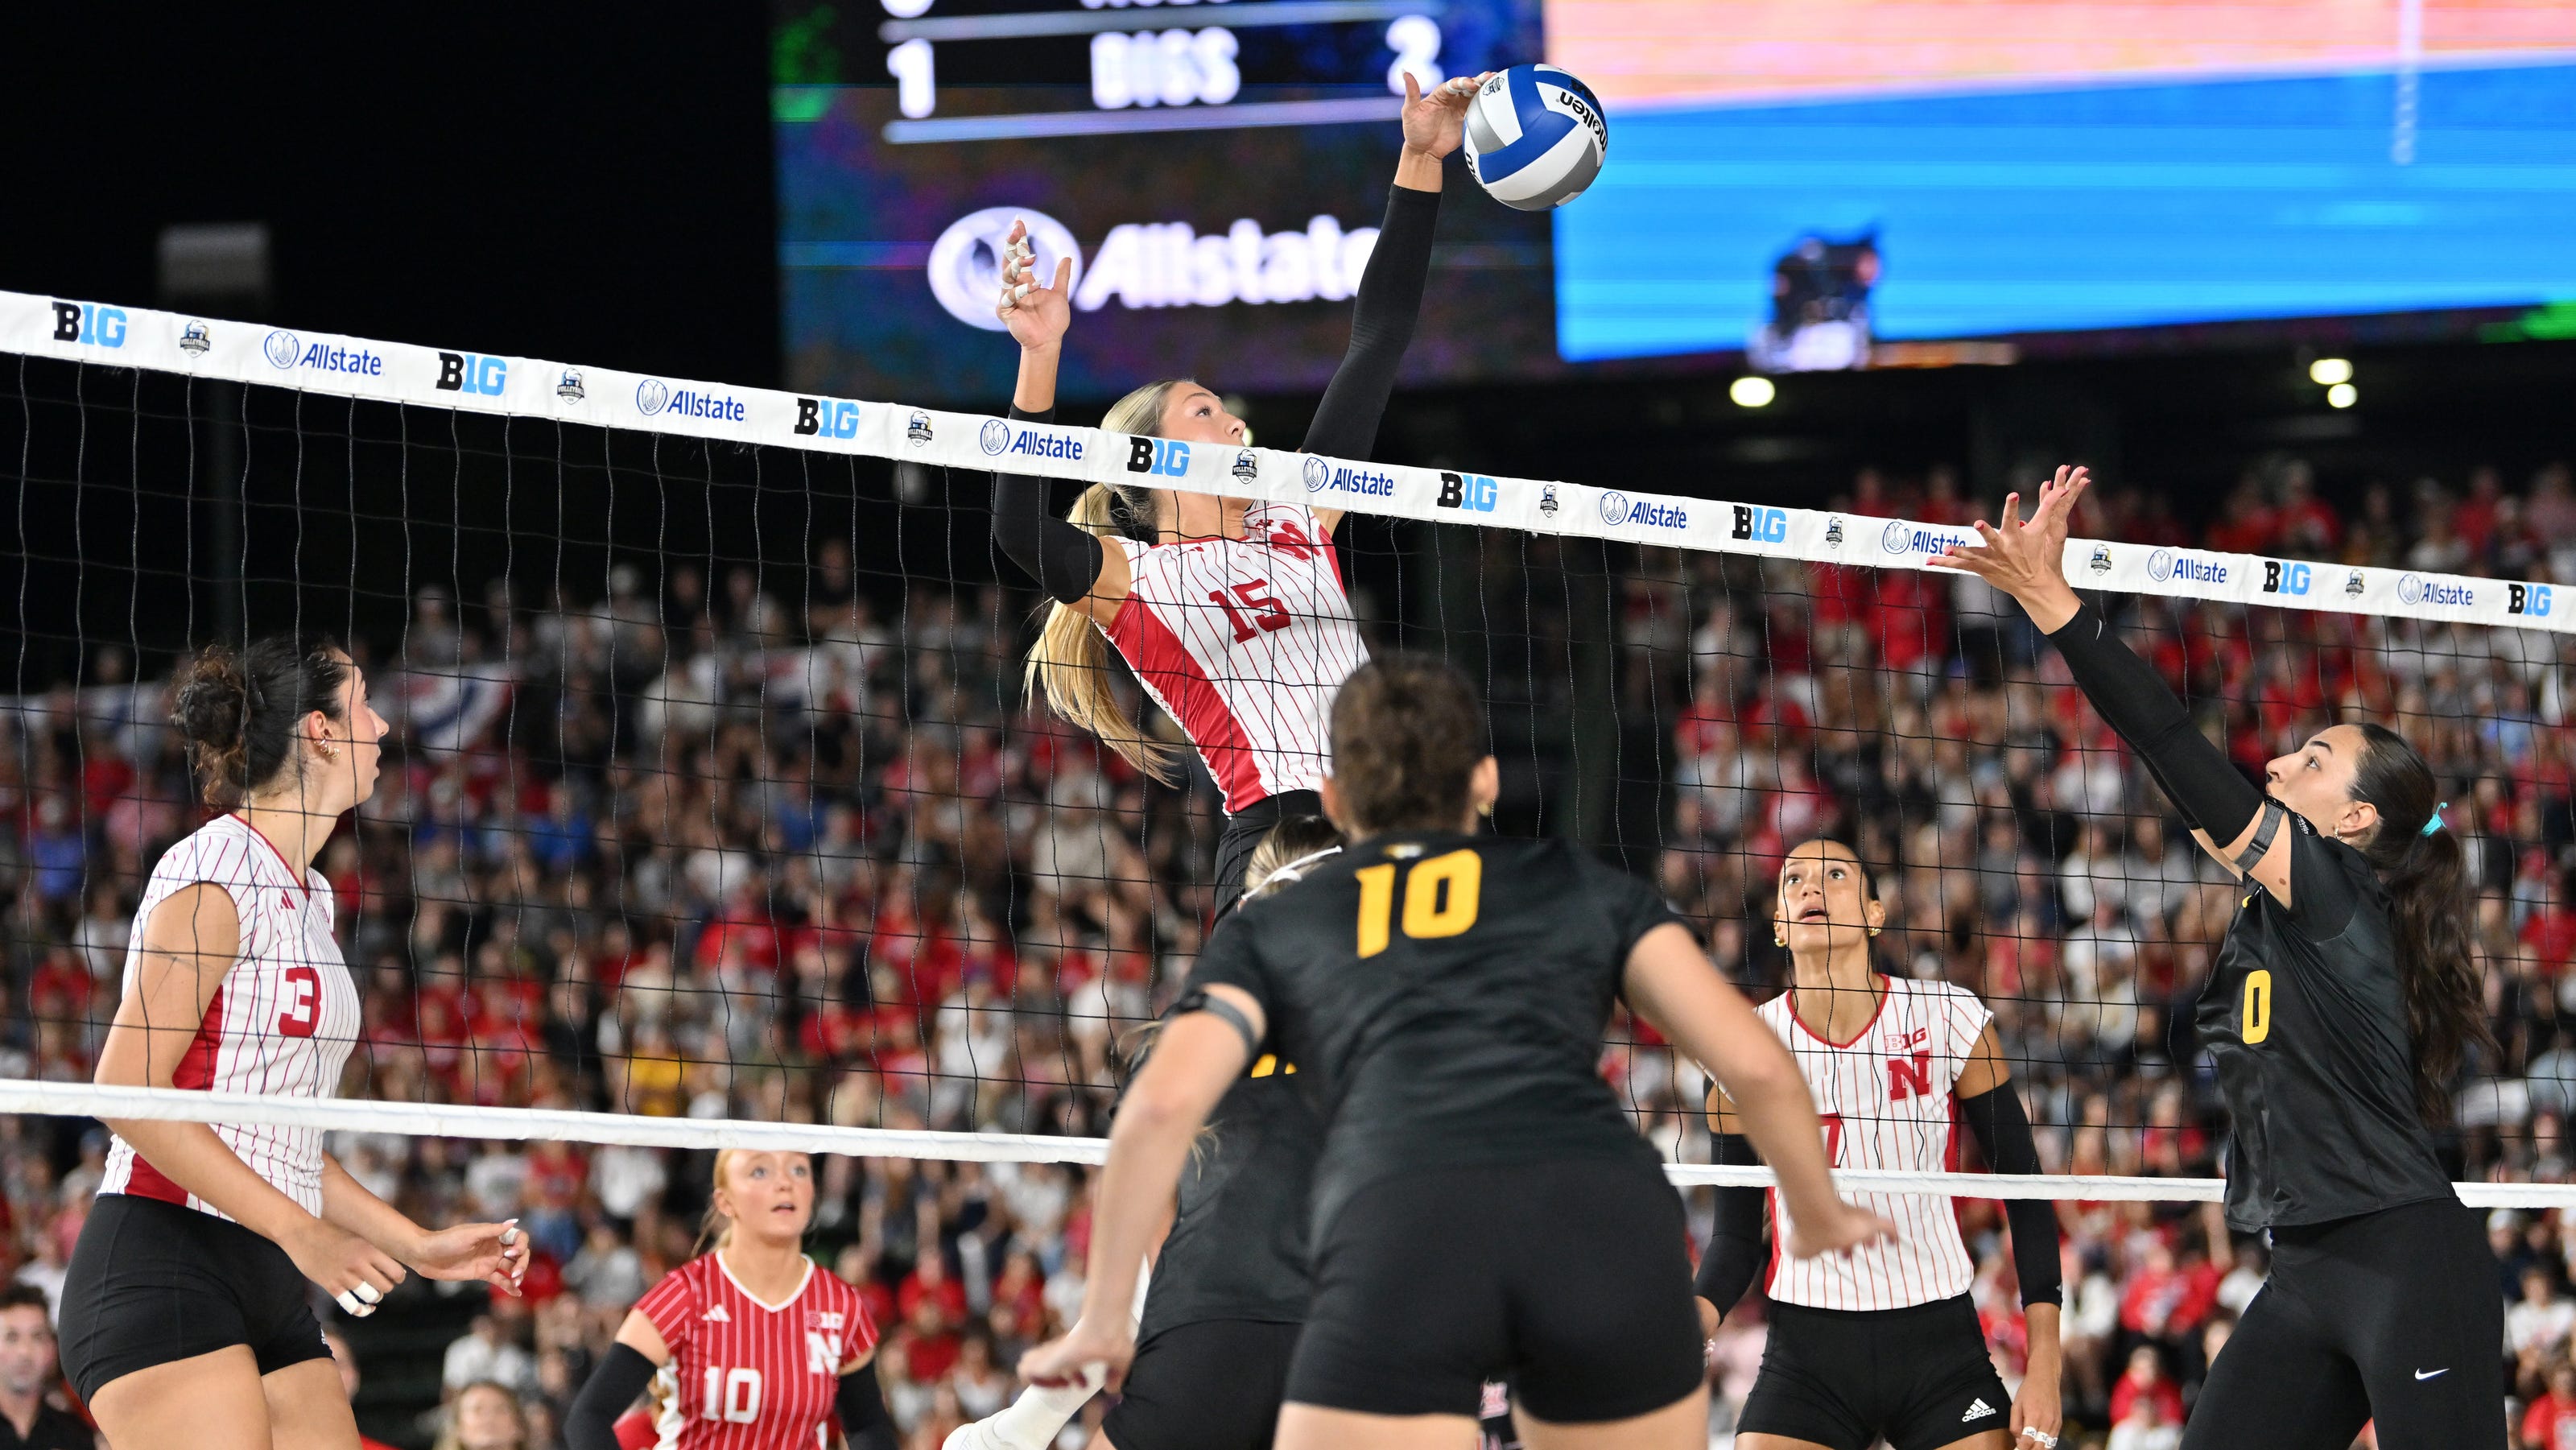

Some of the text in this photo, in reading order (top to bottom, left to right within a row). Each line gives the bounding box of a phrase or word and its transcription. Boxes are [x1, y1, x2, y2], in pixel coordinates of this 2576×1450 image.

[886, 38, 935, 118] 1
[1559, 91, 1607, 152] molten
[300, 343, 382, 376] Allstate
[667, 390, 745, 422] Allstate
[1010, 431, 1083, 461] Allstate
[1330, 468, 1393, 497] Allstate
[1627, 501, 1687, 529] Allstate
[2172, 558, 2227, 584] Allstate
[1208, 578, 1291, 645] 15
[2421, 583, 2473, 606] Allstate
[1356, 849, 1481, 959] 10
[279, 967, 321, 1038] 3
[2242, 969, 2271, 1044] 0
[1886, 1048, 1933, 1101] N
[807, 1332, 842, 1374] N
[702, 1366, 762, 1423] 10
[1962, 1407, 1996, 1423] adidas
